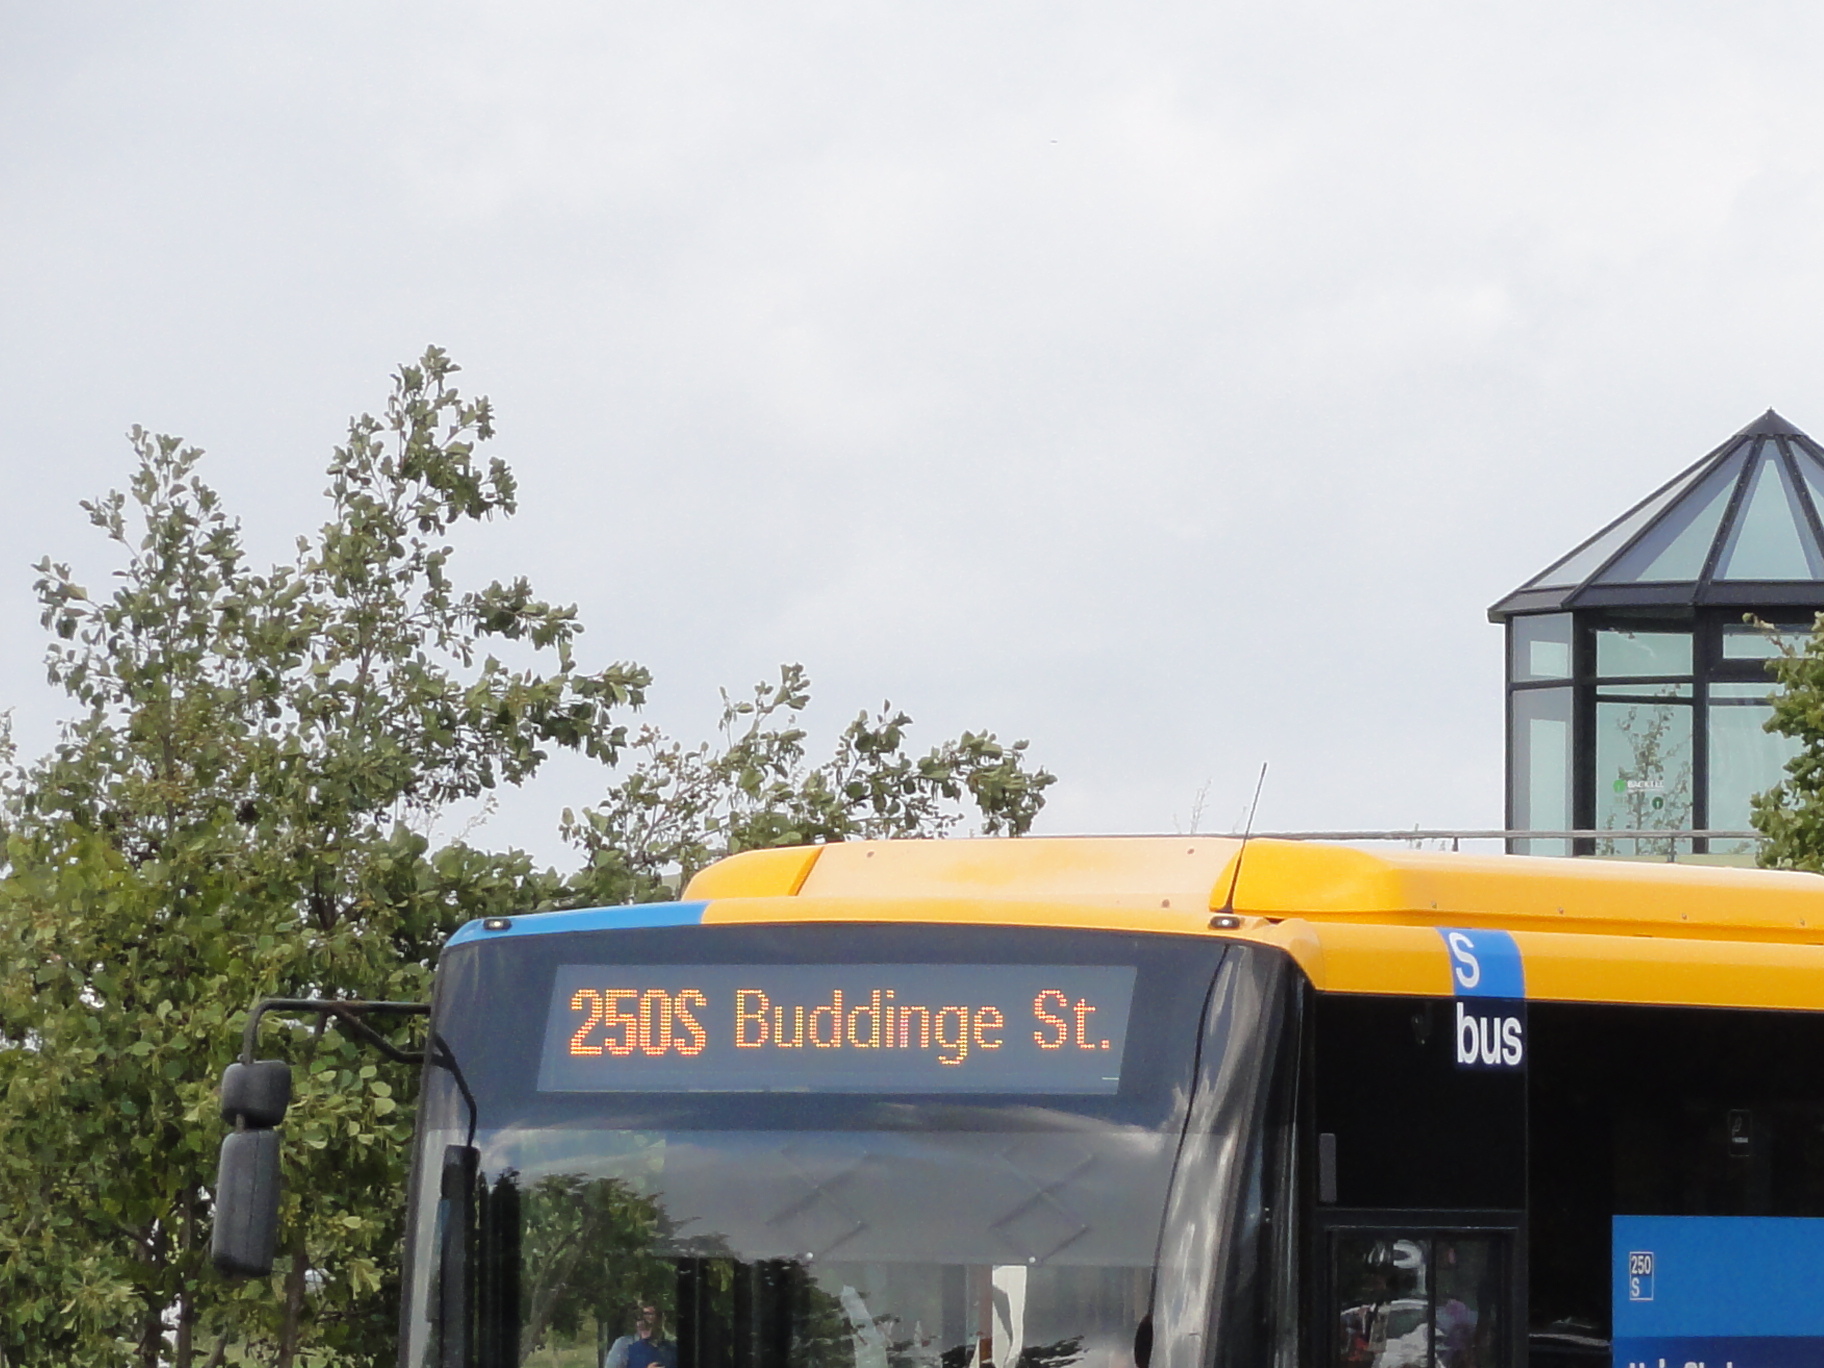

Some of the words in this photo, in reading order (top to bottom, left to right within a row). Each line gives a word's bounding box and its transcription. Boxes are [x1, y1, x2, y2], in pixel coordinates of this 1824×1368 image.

[1448, 932, 1480, 988] S
[570, 989, 707, 1056] 250S
[735, 989, 1003, 1064] Buddinge
[1034, 990, 1109, 1049] St.
[1456, 1002, 1523, 1065] bus
[1630, 1255, 1651, 1274] 250
[1630, 1277, 1640, 1297] S
